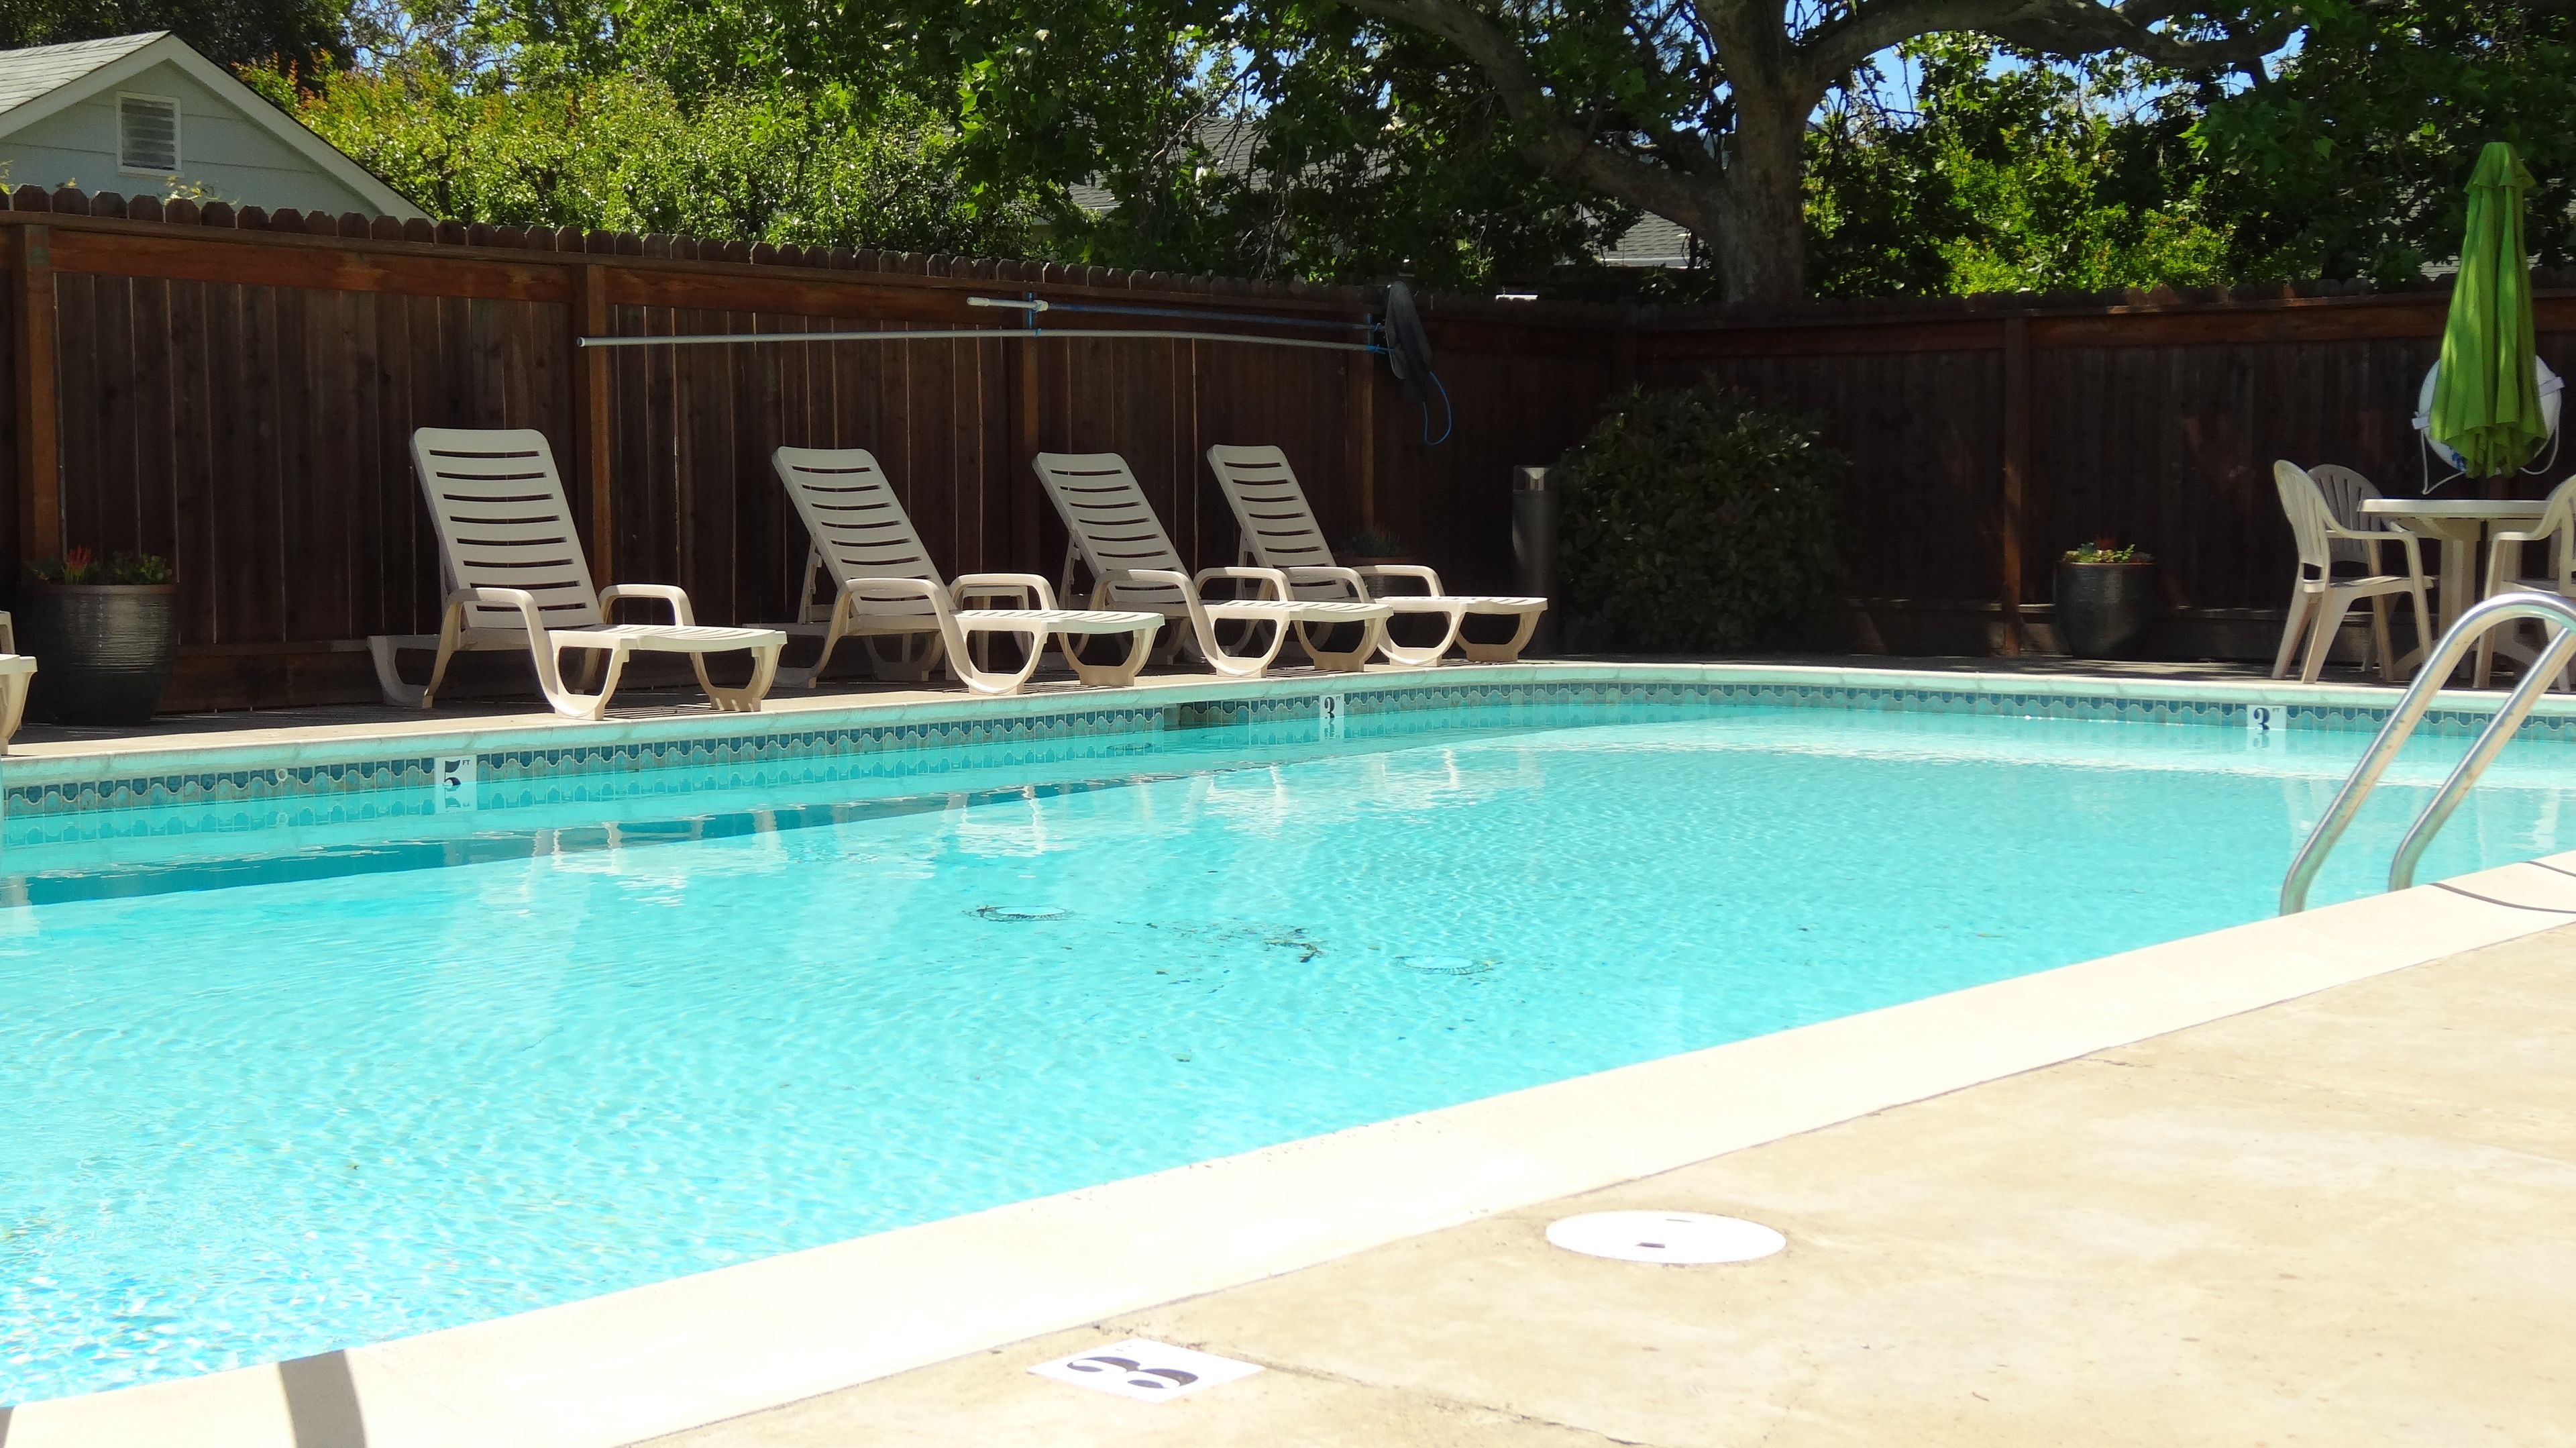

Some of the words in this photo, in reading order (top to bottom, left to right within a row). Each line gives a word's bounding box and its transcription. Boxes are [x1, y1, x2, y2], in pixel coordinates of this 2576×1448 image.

[1324, 696, 1335, 719] 3
[2253, 707, 2270, 730] 3
[444, 759, 462, 786] 5
[1067, 1355, 1199, 1389] 3
